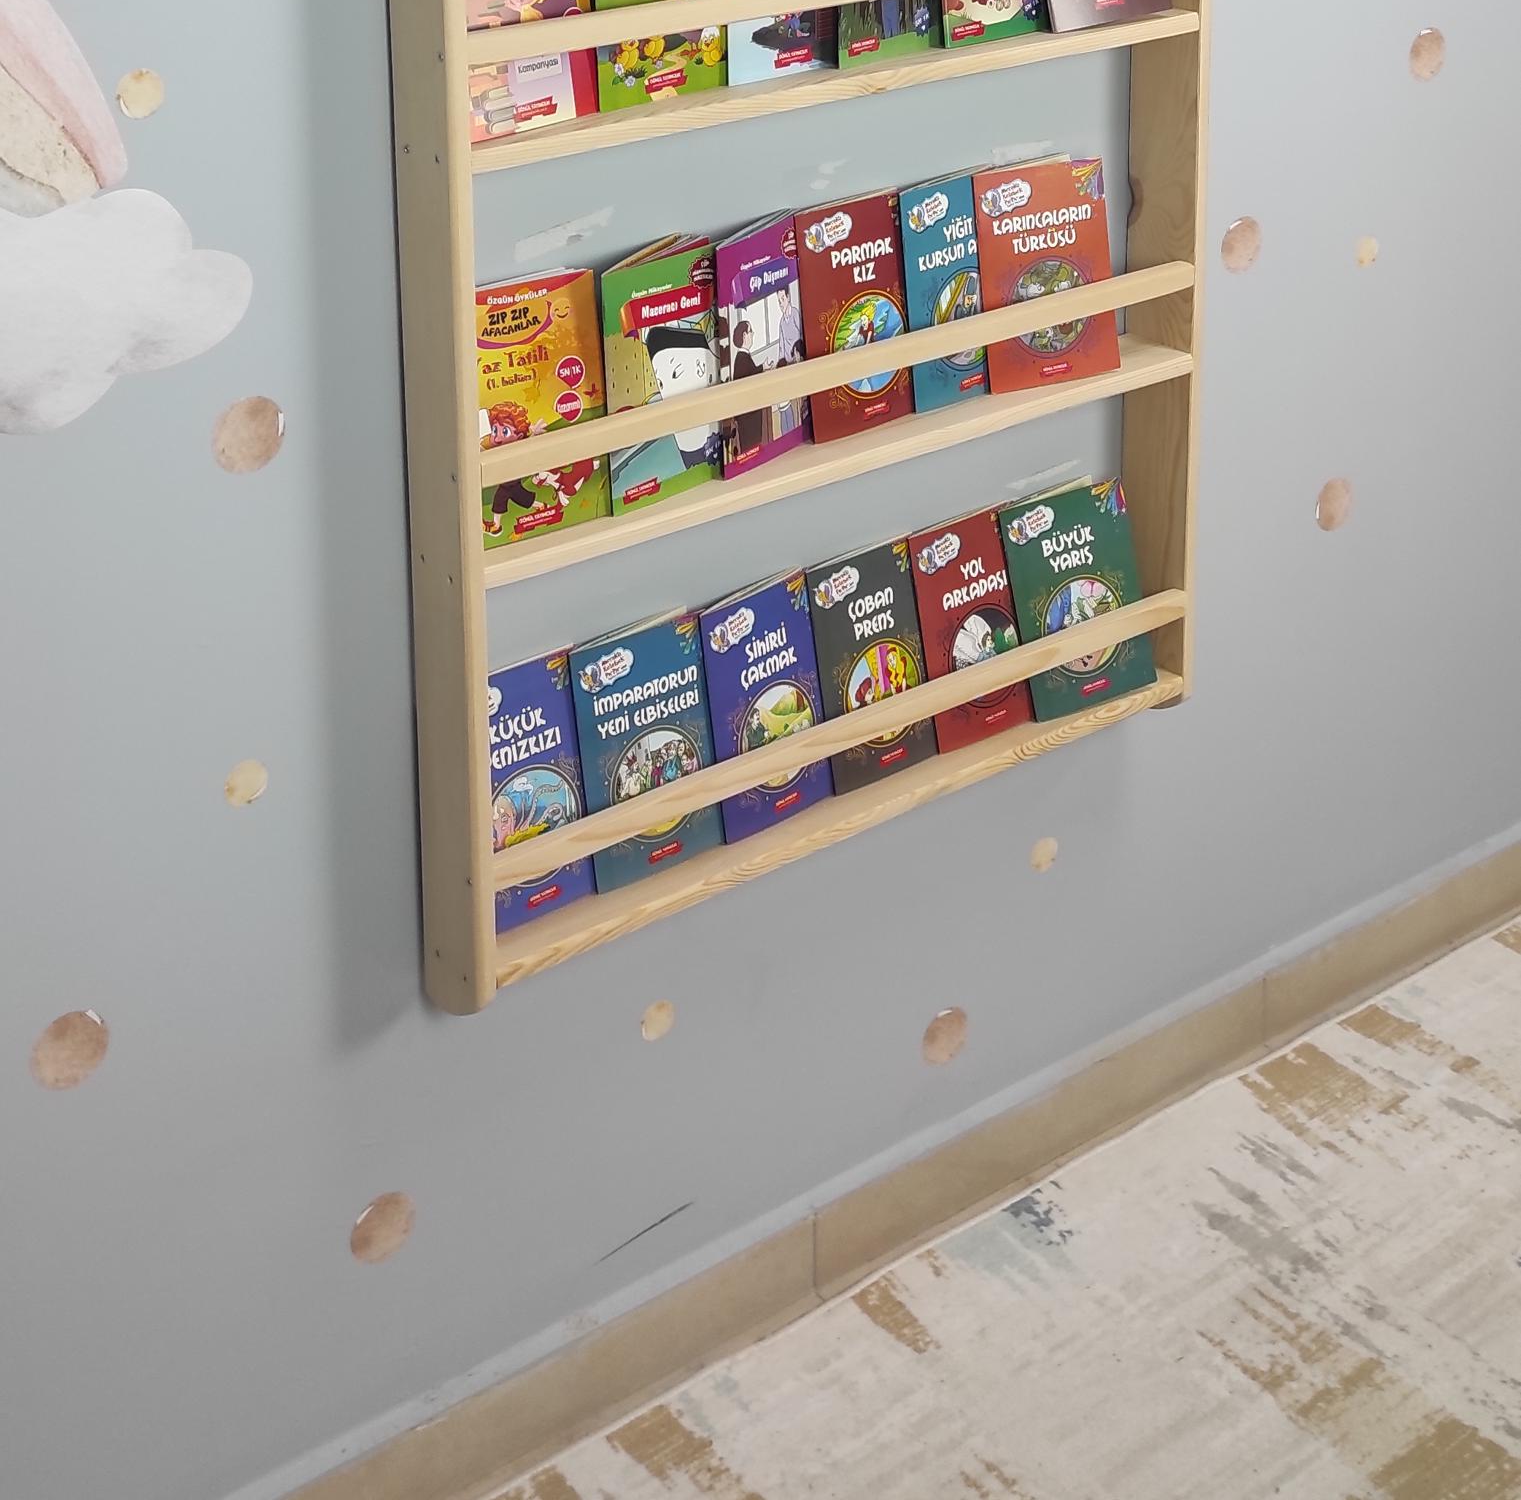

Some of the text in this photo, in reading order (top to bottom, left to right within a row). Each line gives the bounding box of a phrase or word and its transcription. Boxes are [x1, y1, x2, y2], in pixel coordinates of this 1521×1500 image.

[518, 57, 559, 75] Kampanyası
[942, 214, 973, 243] YİĞİT
[992, 203, 1092, 236] KARINCALARIN
[830, 236, 894, 269] PARMAK
[1012, 224, 1076, 255] TÜRKÜSÜ
[852, 261, 876, 284] KIZ
[918, 242, 965, 272] KURŞUN
[486, 288, 548, 306] ÖZGÜN ÖYKÜLER
[749, 275, 762, 293] Çöp
[488, 306, 530, 326] ZIP ZIP
[641, 292, 701, 320] Maceracı Gemi
[481, 315, 542, 338] AFACANLAR
[477, 344, 550, 375] az Tatili
[1041, 524, 1095, 558] BÜYÜK
[960, 556, 985, 580] YOL
[1049, 545, 1094, 574] YARIŞ
[847, 586, 894, 623] ÇOBAN
[942, 569, 1008, 611] ARKADAŞI
[853, 609, 895, 641] PRENS
[745, 621, 787, 663] SİHİRLİ
[740, 646, 798, 691] ÇAKMAK
[593, 665, 698, 717] İMPARATORUN
[489, 706, 547, 745] KÜÇÜK
[597, 683, 700, 740] YENİ ELBİSELERİ
[490, 726, 562, 769] ENİZKIZI
